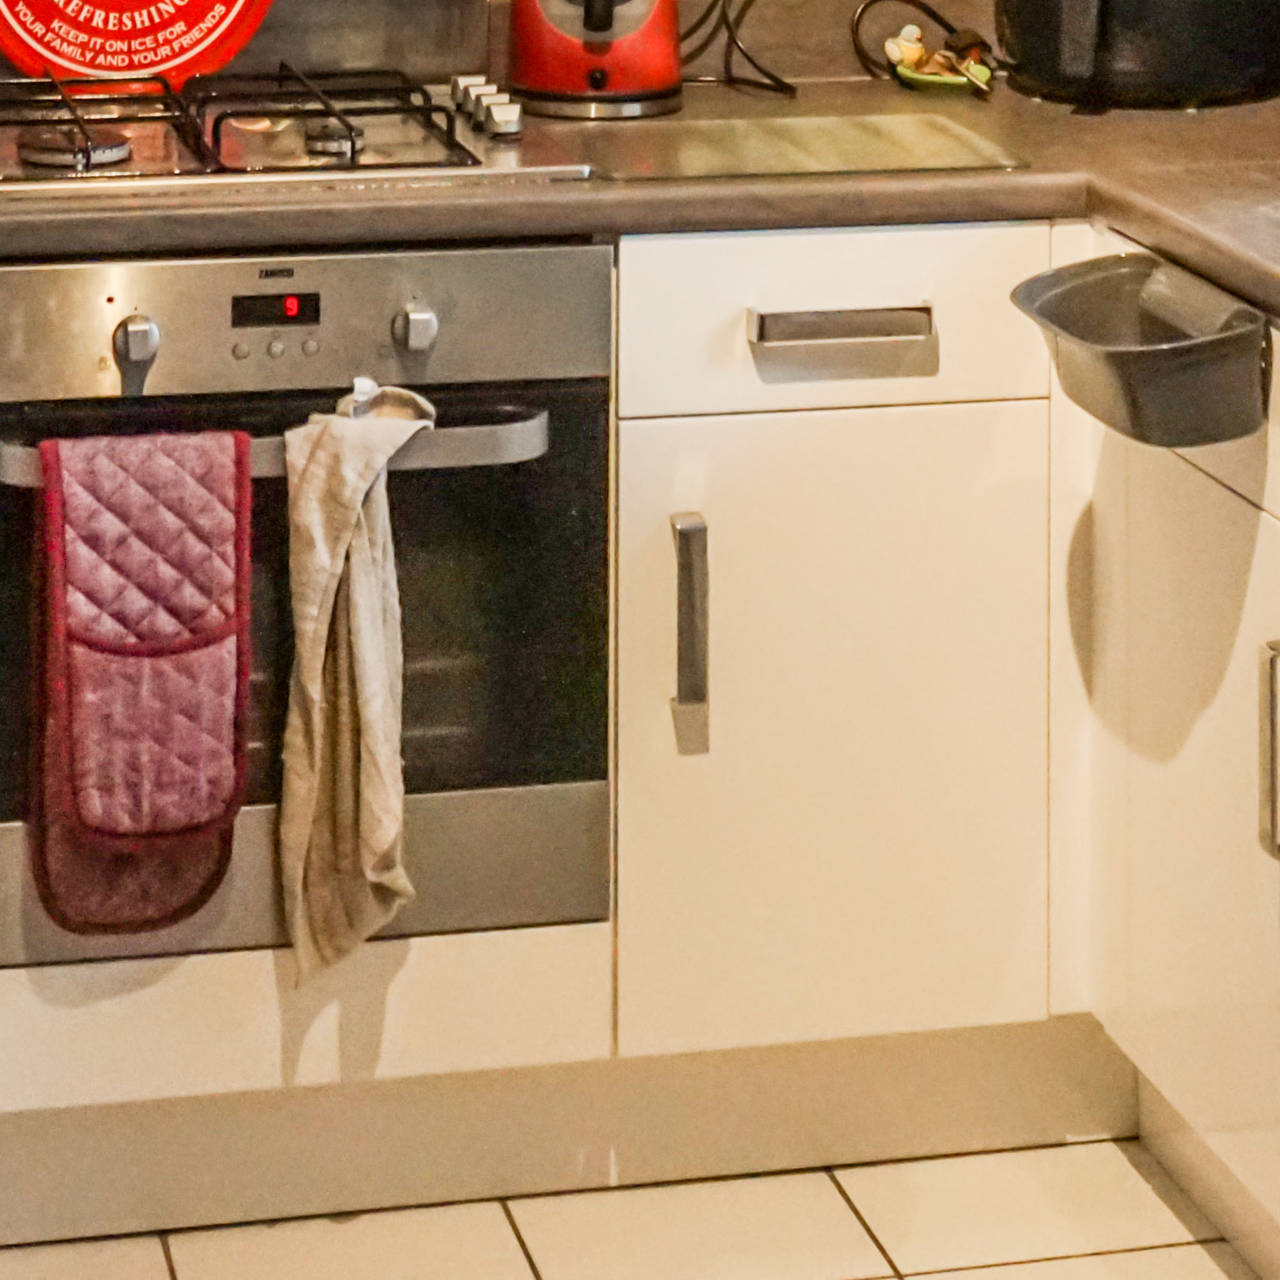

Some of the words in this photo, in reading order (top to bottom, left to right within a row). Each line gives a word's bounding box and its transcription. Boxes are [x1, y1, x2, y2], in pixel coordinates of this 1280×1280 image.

[14, 1, 45, 38] YOUR
[44, 32, 95, 65] FAMILY
[95, 53, 129, 67] AND
[131, 46, 172, 65] YOUR
[172, 3, 227, 54] FRIENDS
[50, 19, 88, 44] KEEP
[89, 37, 105, 52] IT
[105, 39, 129, 53] ON
[131, 35, 155, 52] ICE
[157, 21, 187, 45] FOR
